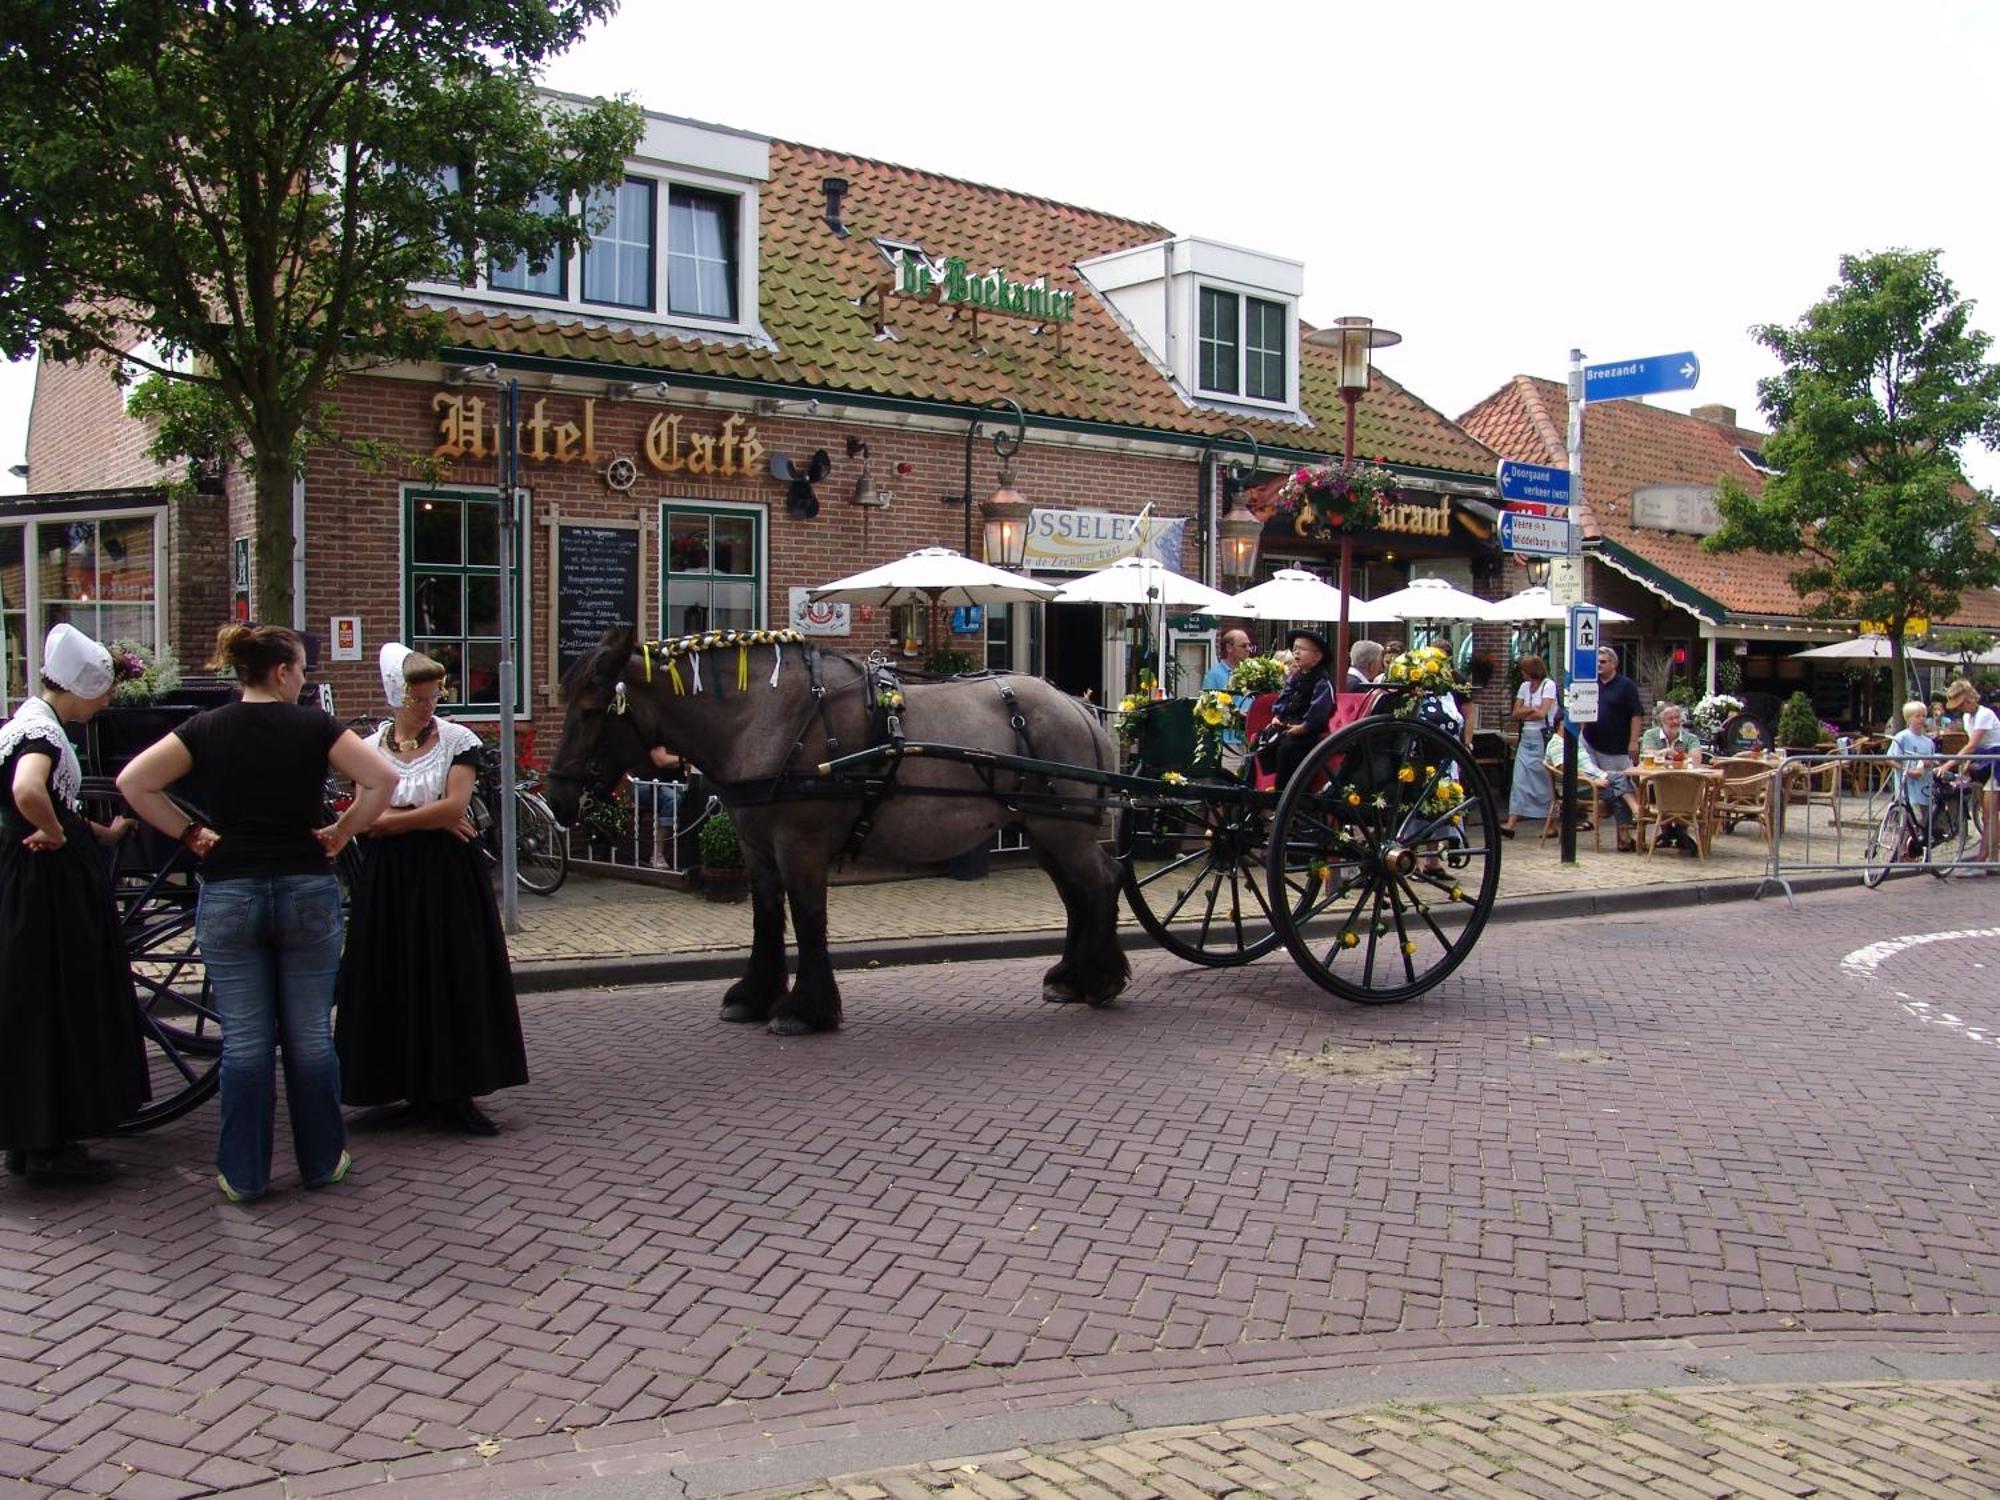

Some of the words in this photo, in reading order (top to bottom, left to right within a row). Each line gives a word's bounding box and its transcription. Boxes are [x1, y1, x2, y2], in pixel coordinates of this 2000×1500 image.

[1587, 364, 1636, 380] Breezand
[1639, 364, 1645, 373] 1
[646, 411, 766, 477] Café
[1511, 466, 1551, 482] Doorgaand
[1523, 485, 1551, 498] verkeer
[1513, 518, 1533, 530] Veere
[1513, 534, 1550, 549] Middelburg
